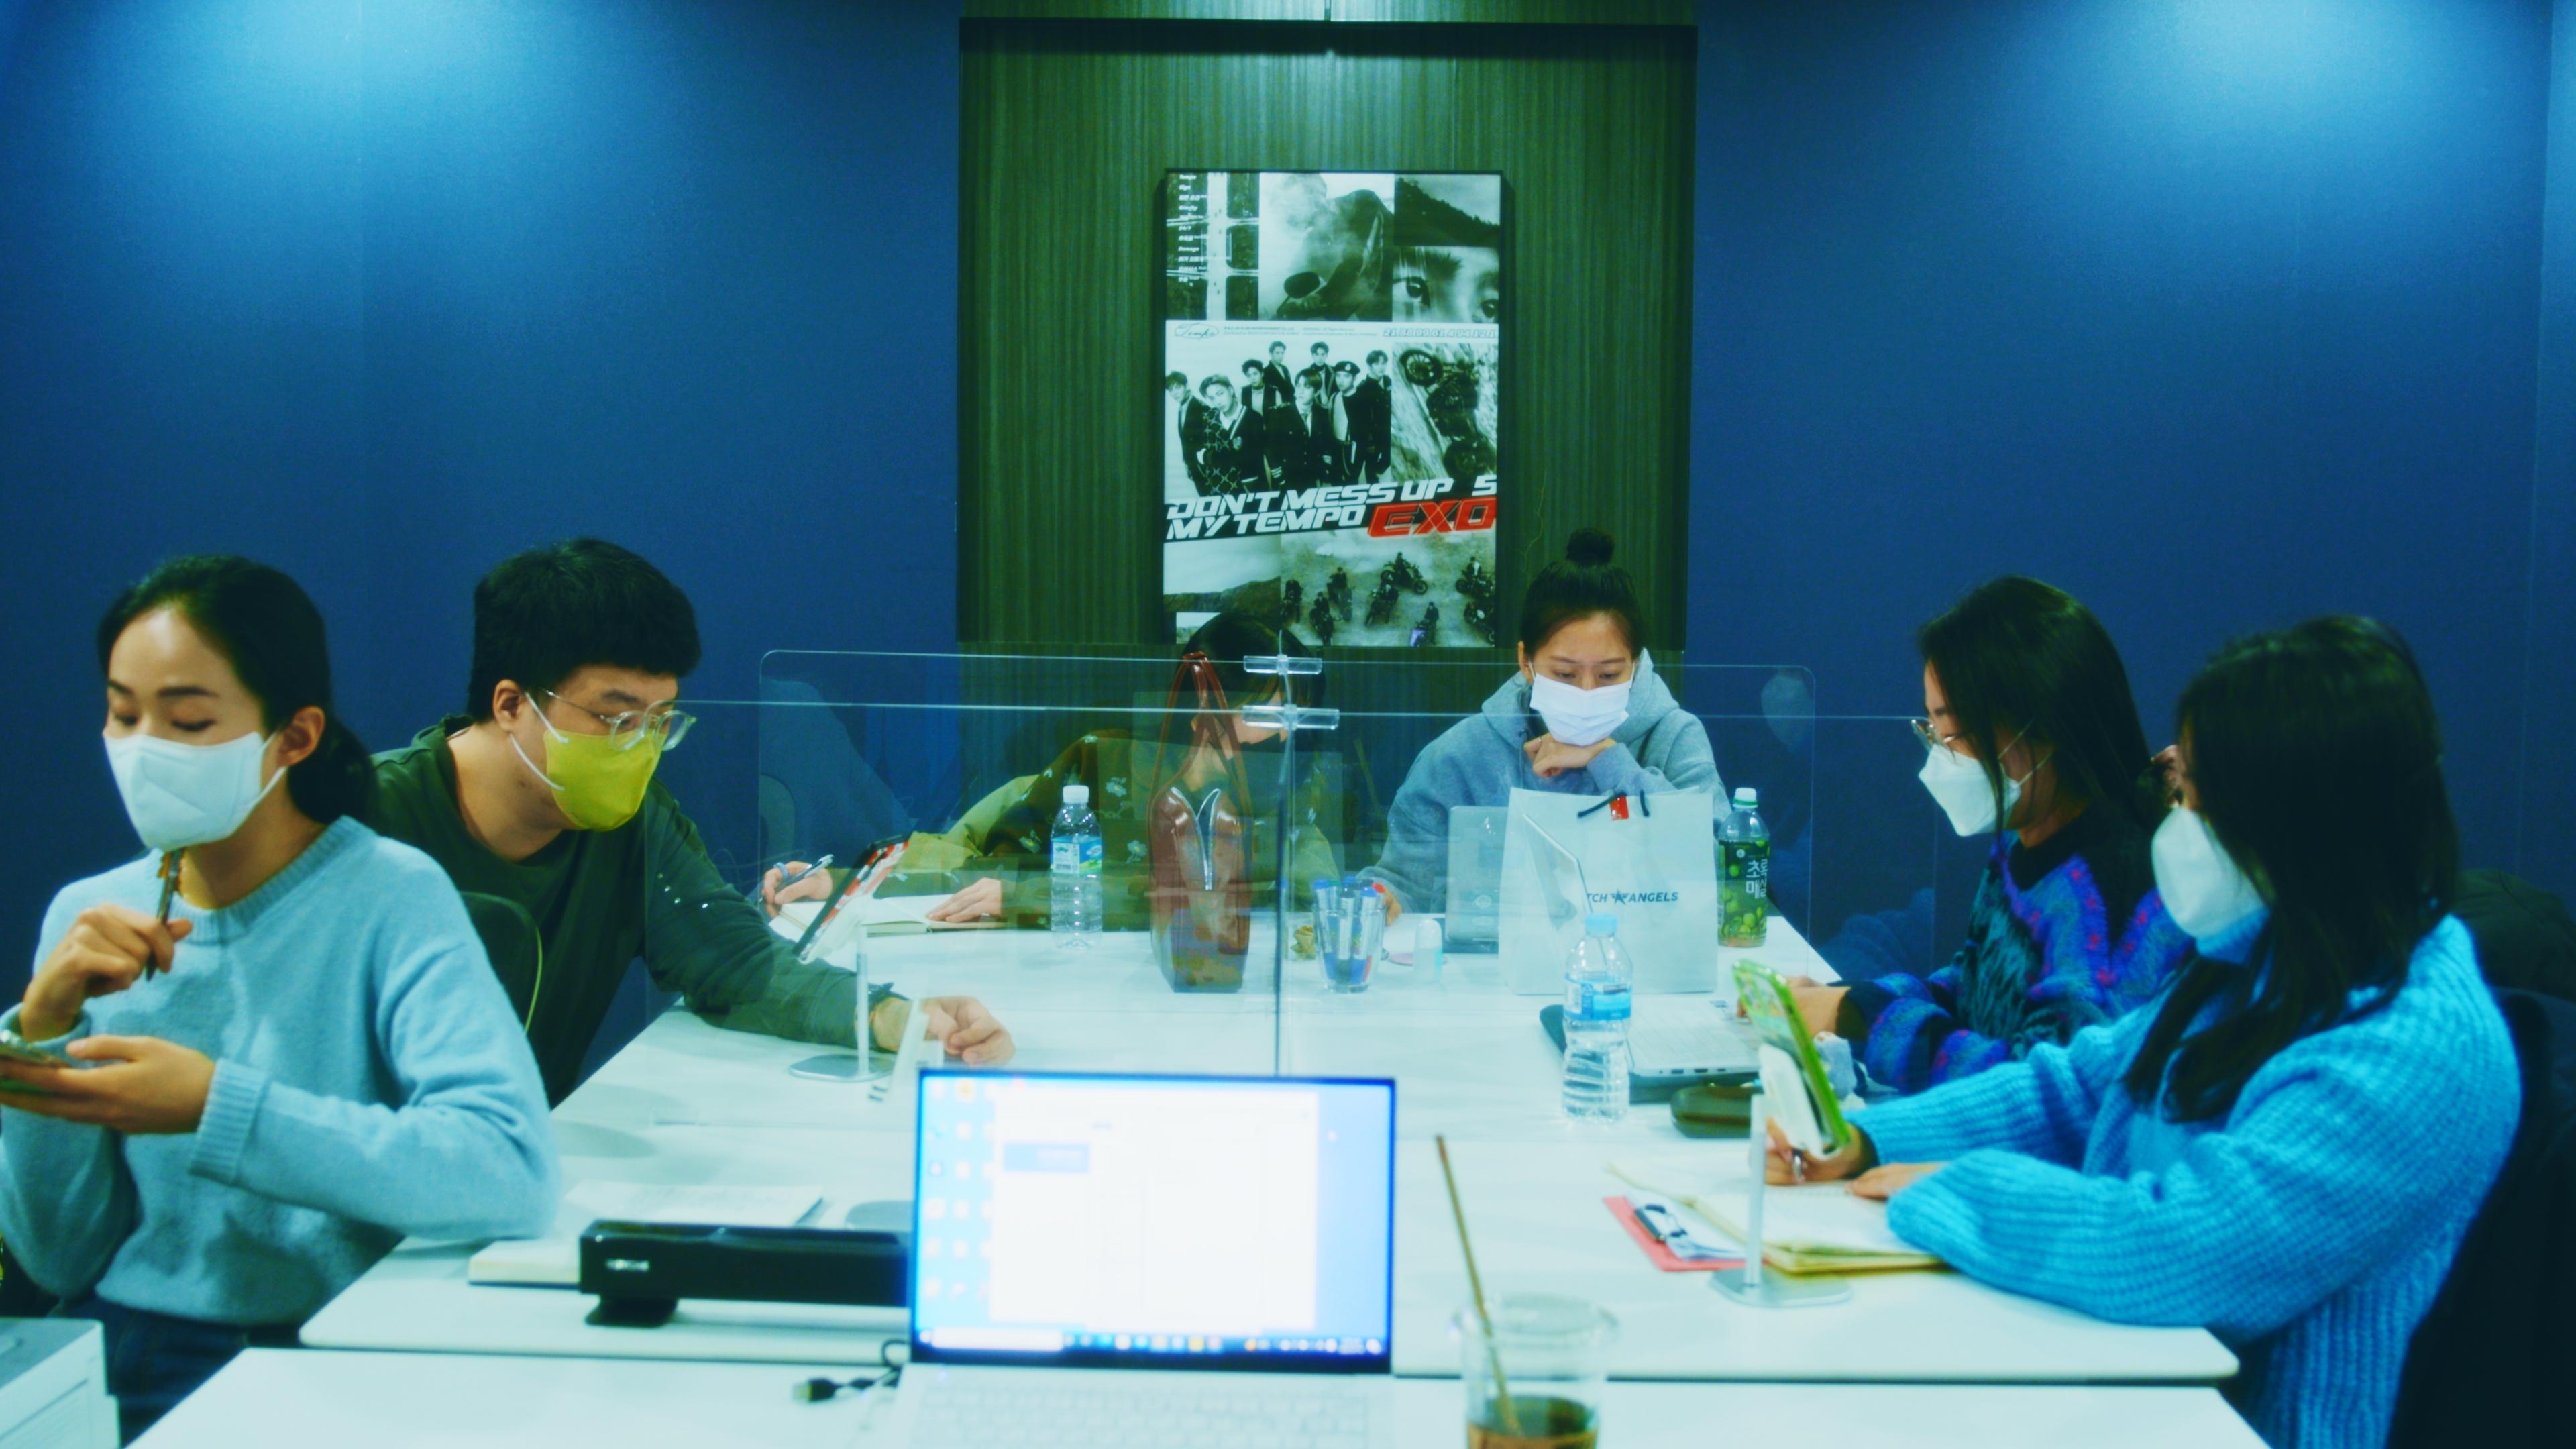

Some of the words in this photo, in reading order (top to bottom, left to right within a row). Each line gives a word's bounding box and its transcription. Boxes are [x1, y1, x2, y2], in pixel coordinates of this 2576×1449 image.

[1166, 491, 1280, 519] DON'T
[1281, 482, 1397, 511] MESS
[1400, 478, 1454, 502] UP
[1166, 515, 1231, 540] MY
[1233, 504, 1366, 534] TEMPO
[1367, 496, 1497, 538] EXO
[1629, 892, 1678, 902] ANGELS
